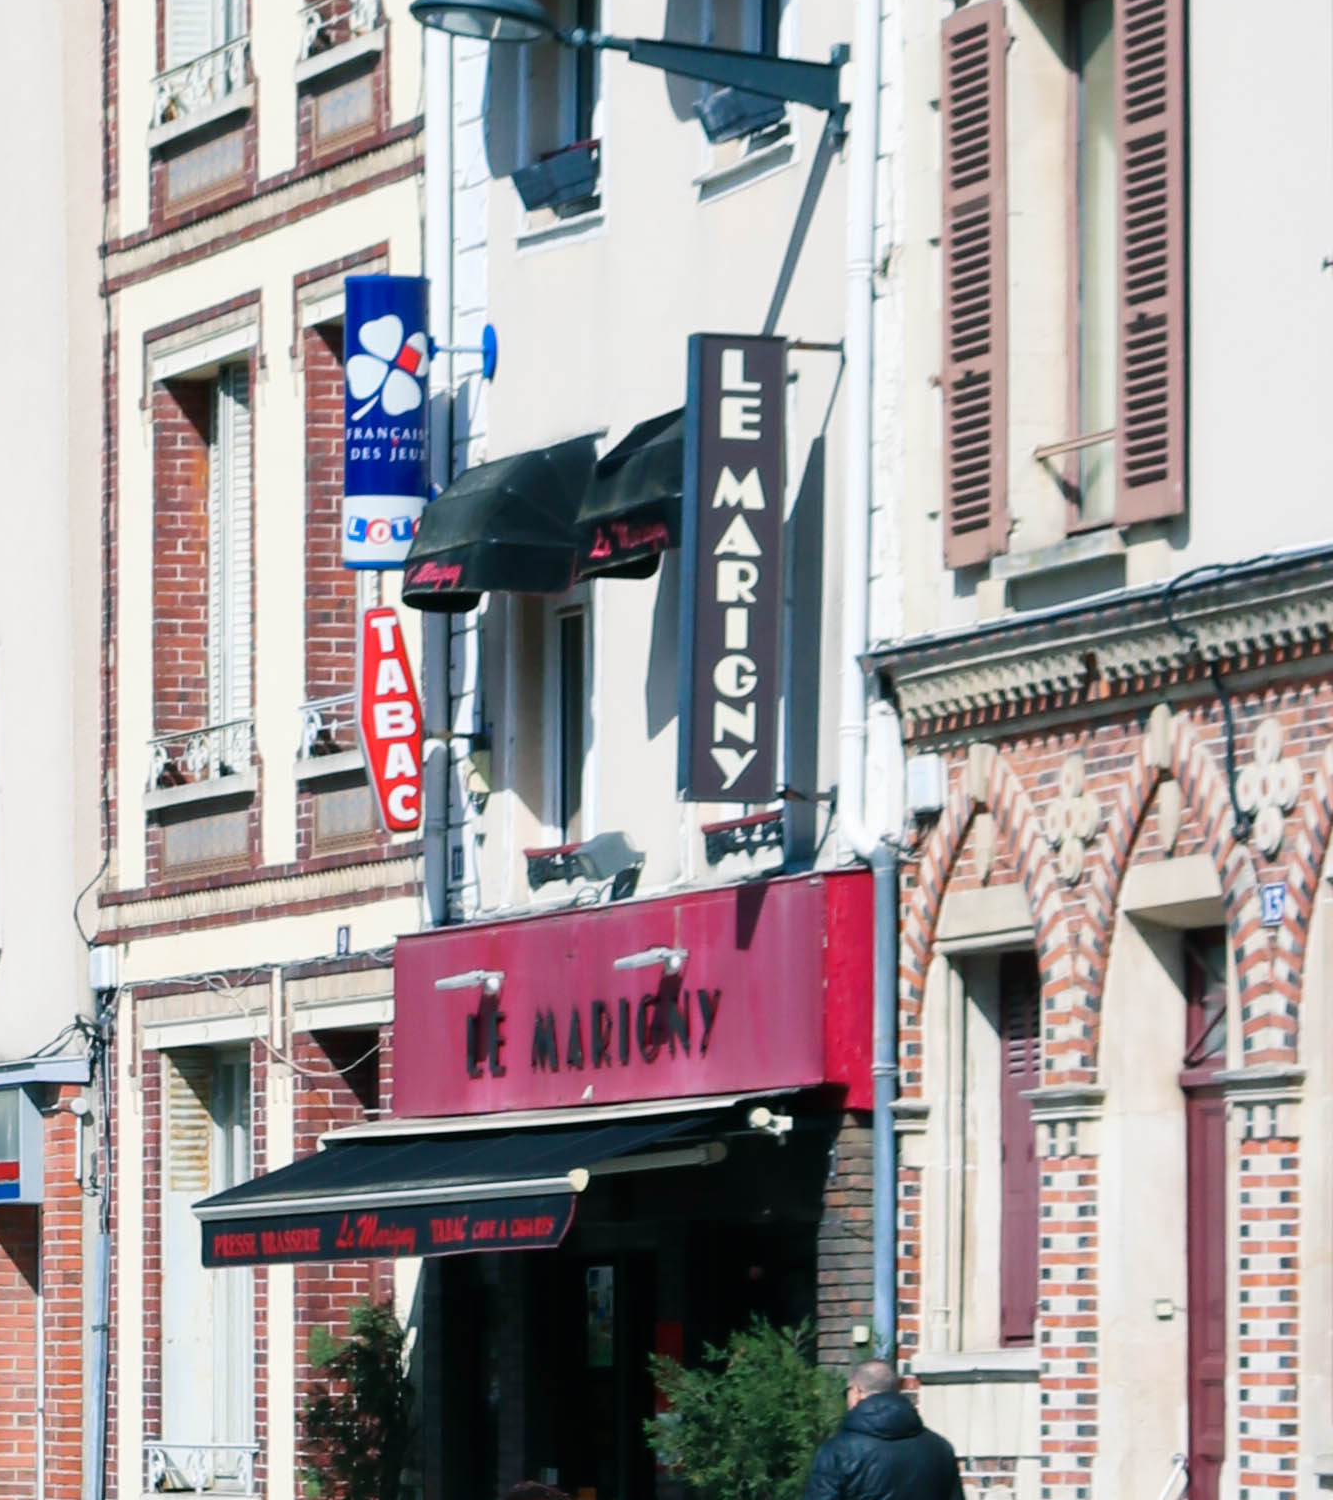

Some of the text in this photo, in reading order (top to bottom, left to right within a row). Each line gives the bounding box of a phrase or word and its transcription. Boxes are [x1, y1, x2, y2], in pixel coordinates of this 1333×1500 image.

[350, 447, 382, 461] DES
[710, 349, 766, 790] LE MARIGNY
[370, 615, 418, 823] TABAC
[466, 988, 722, 1080] LE MARIGNY
